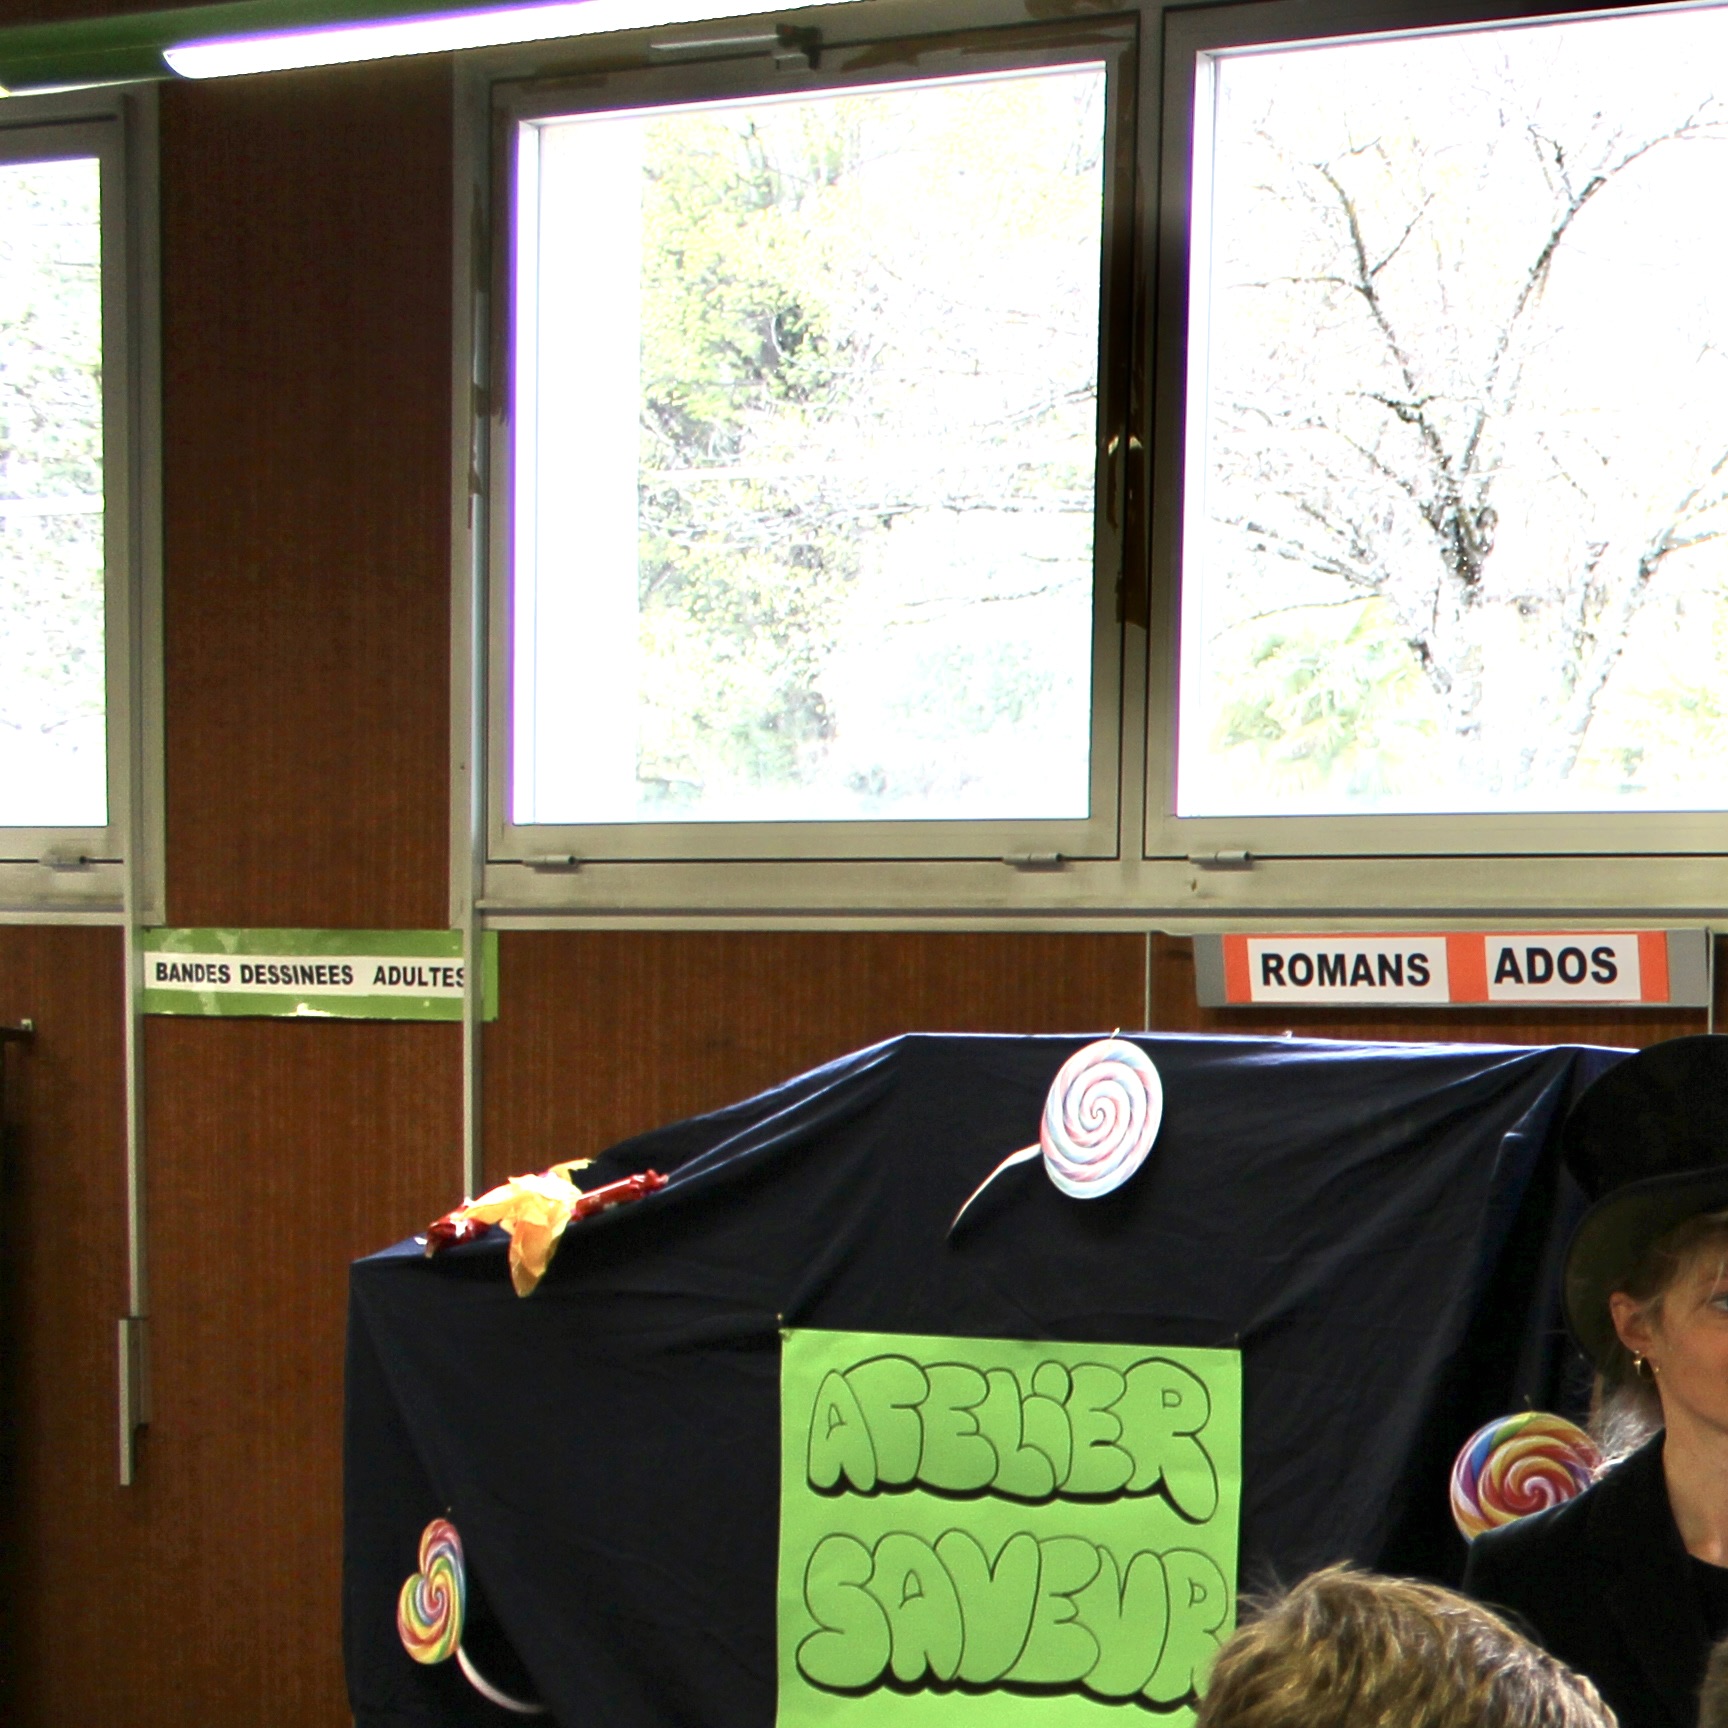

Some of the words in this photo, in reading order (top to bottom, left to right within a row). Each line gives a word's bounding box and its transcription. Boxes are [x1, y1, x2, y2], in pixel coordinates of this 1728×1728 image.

[156, 962, 231, 984] BANDES
[240, 964, 354, 986] DESSINEES
[372, 965, 464, 988] ADULTES
[1260, 952, 1431, 987] ROMANS
[1493, 946, 1618, 985] ADOS
[796, 1527, 1230, 1714] SAVEUR
